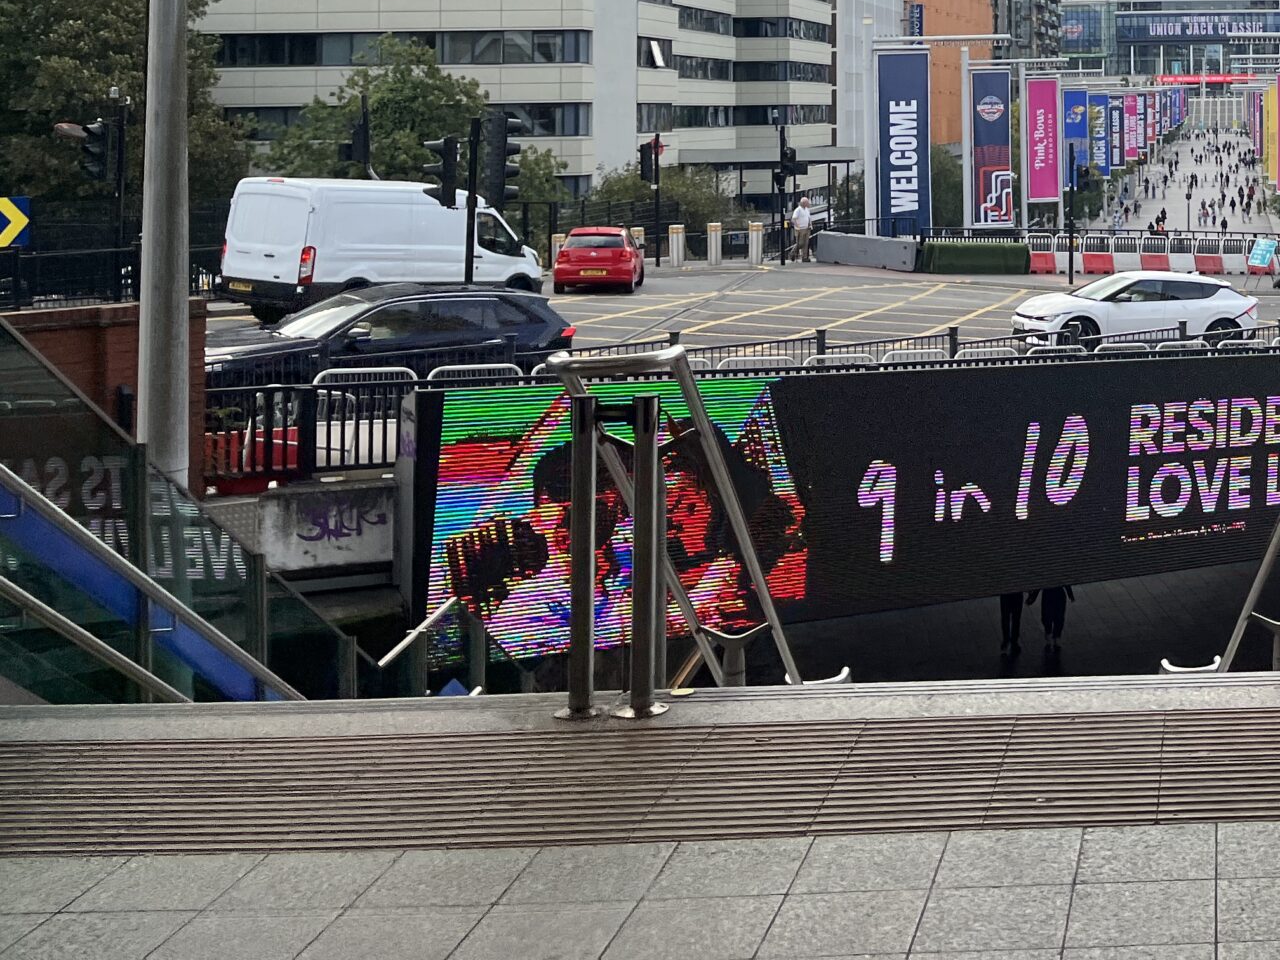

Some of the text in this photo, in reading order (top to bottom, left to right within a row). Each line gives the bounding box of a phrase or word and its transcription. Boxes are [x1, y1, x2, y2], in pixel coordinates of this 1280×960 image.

[1150, 22, 1263, 35] UNION JACK CLASSIC
[889, 99, 919, 214] WELCOME
[1034, 109, 1046, 170] Pink Bows
[857, 413, 1090, 563] 9 in 10
[1125, 455, 1252, 522] LOVE
